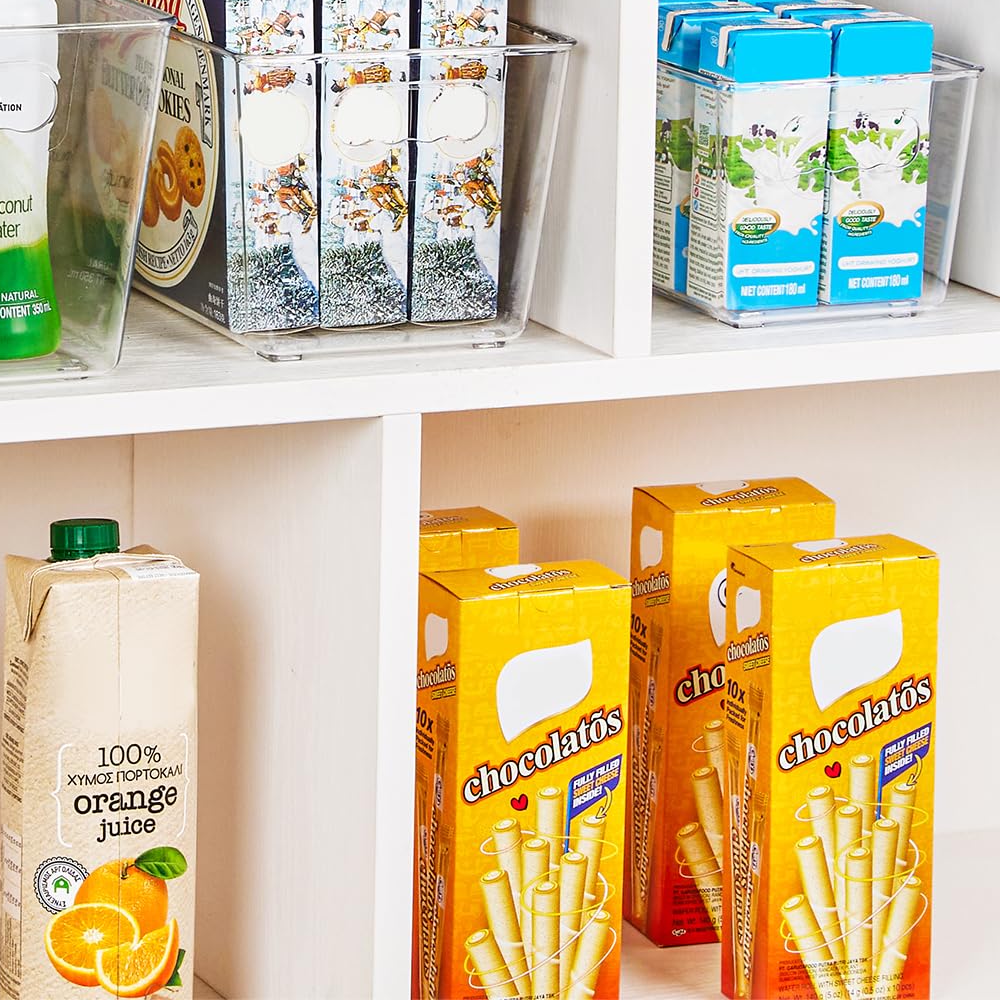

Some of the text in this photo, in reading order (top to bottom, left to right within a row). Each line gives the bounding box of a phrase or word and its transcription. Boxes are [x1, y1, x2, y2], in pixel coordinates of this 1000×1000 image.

[158, 89, 191, 123] OKIES
[757, 284, 786, 297] CONTENT
[861, 276, 890, 289] CONTENT
[0, 289, 39, 303] NATURAL
[32, 302, 44, 315] 350
[884, 726, 930, 757] FULLY FILLED
[884, 738, 929, 766] SWEET CHEESE
[98, 743, 161, 767] 100%
[884, 753, 913, 776] INSIDE!
[67, 771, 114, 786] ΧΥΜΟΣ
[573, 758, 620, 790] FULLY FILLED
[573, 767, 619, 798] SWEET CHEESE
[73, 784, 178, 815] orange
[572, 785, 603, 809] INSIDE!
[96, 816, 156, 842] juice
